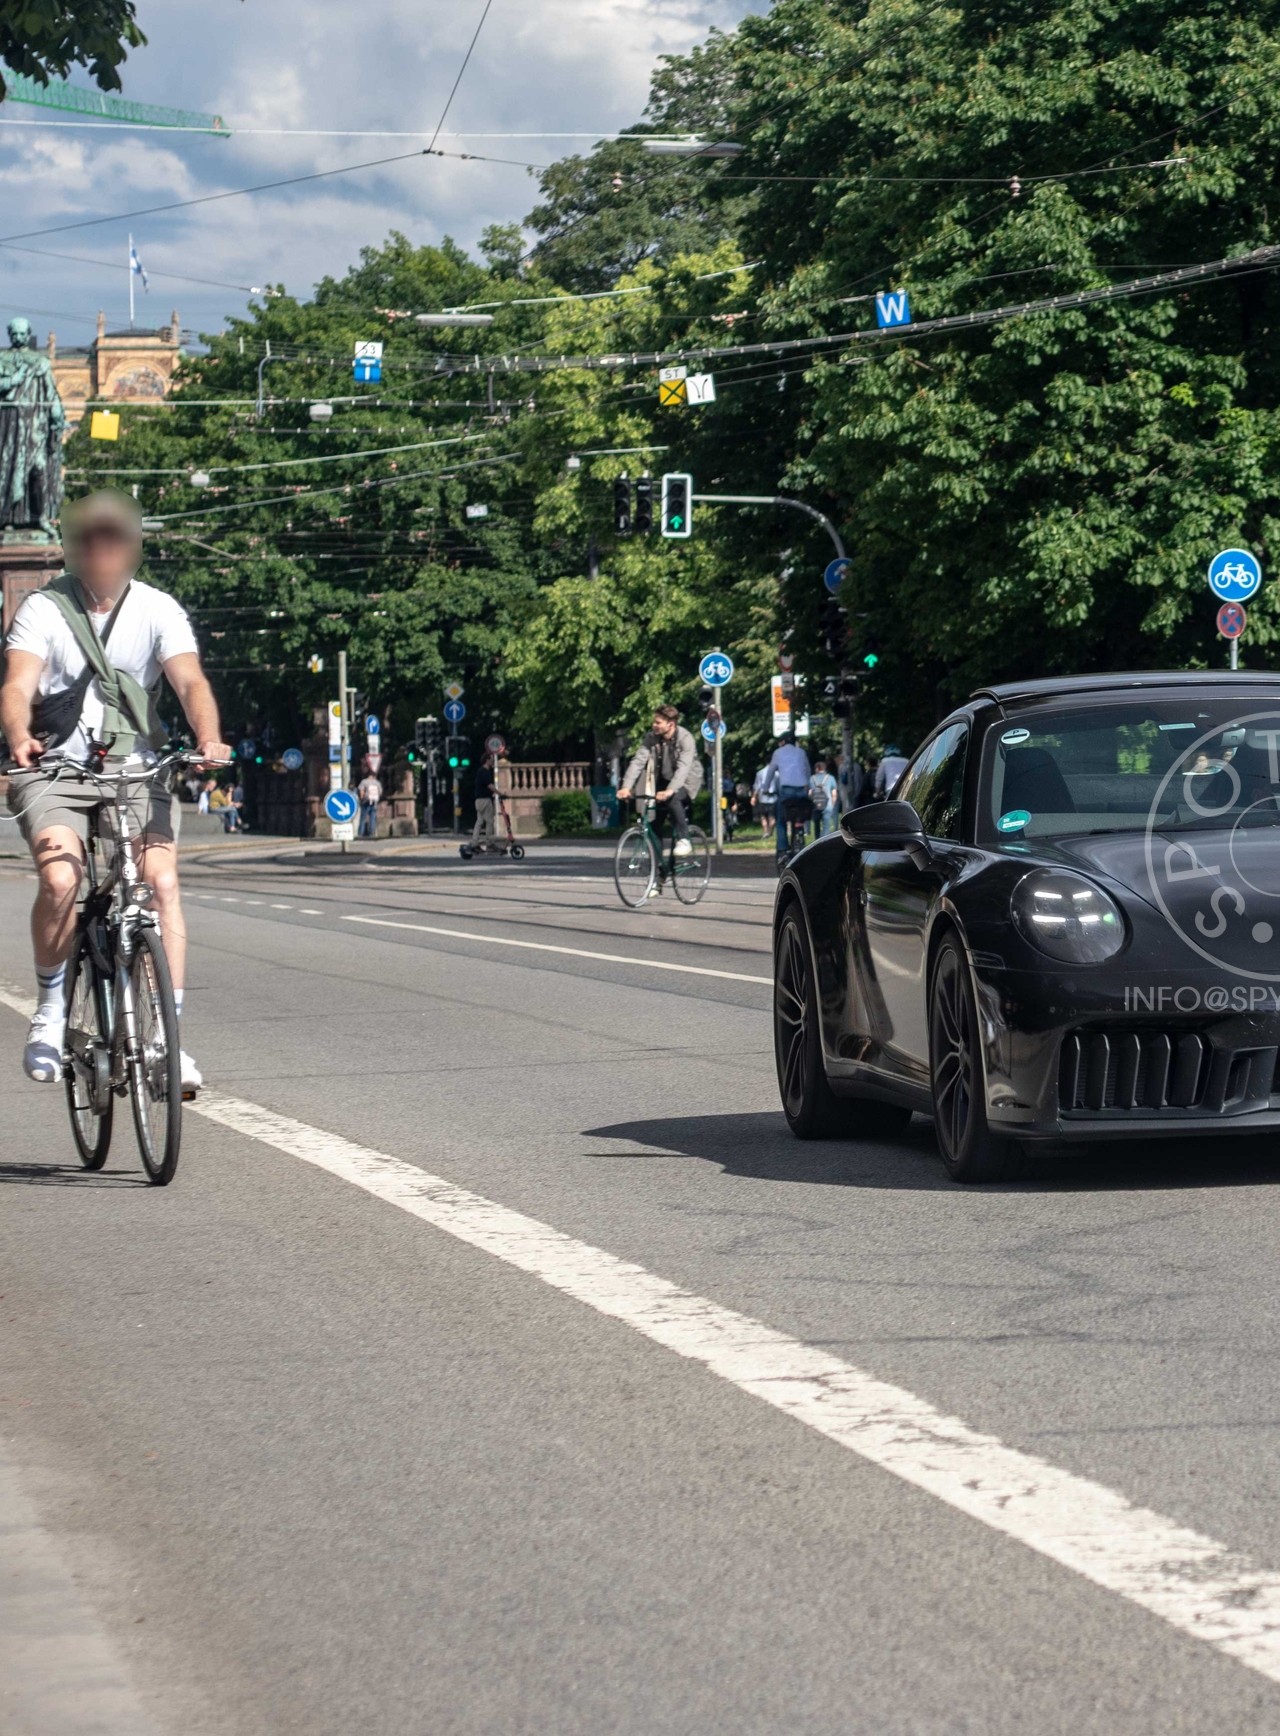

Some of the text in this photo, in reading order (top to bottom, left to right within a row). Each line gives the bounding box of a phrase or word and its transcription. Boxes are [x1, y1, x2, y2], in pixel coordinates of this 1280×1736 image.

[877, 295, 906, 324] W
[360, 358, 376, 380] T
[664, 368, 681, 379] ST
